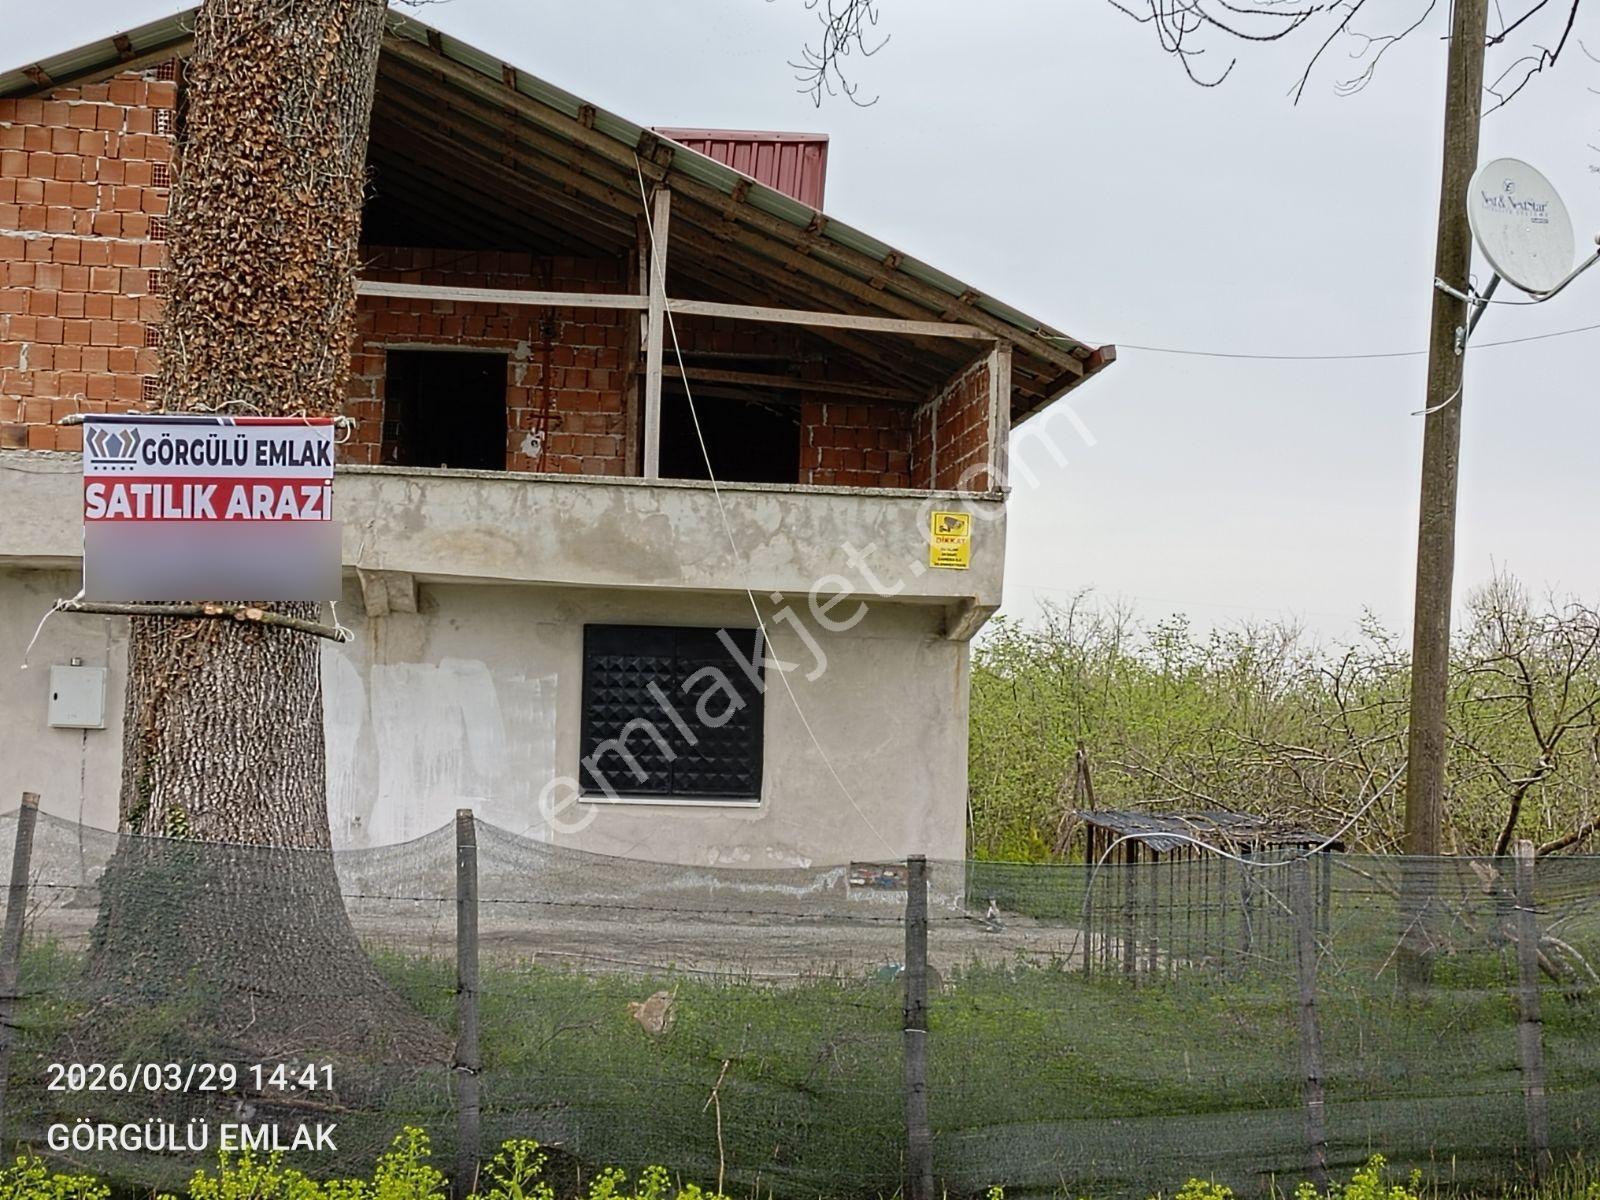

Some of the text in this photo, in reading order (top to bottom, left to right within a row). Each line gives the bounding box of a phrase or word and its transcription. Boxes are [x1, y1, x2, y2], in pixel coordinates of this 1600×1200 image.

[142, 433, 331, 467] GÖRGÜLÜ EMLAK
[85, 479, 331, 521] SATILIK ARAZİ
[935, 536, 966, 545] DİKKAT
